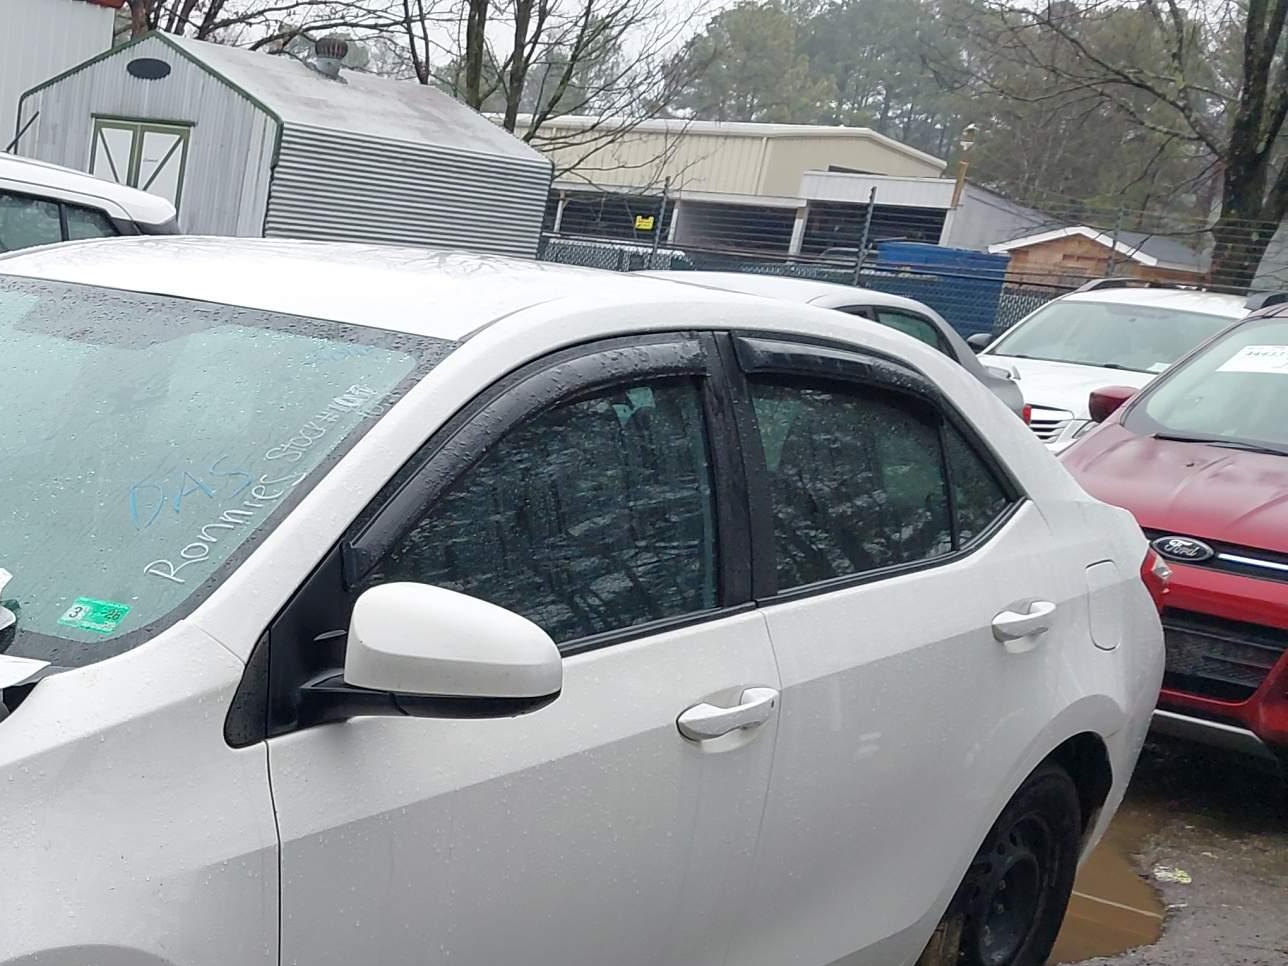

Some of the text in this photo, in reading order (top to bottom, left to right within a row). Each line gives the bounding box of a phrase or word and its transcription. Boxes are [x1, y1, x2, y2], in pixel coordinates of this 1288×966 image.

[129, 455, 255, 532] DAS
[1164, 539, 1201, 557] Ford
[68, 606, 84, 618] 3
